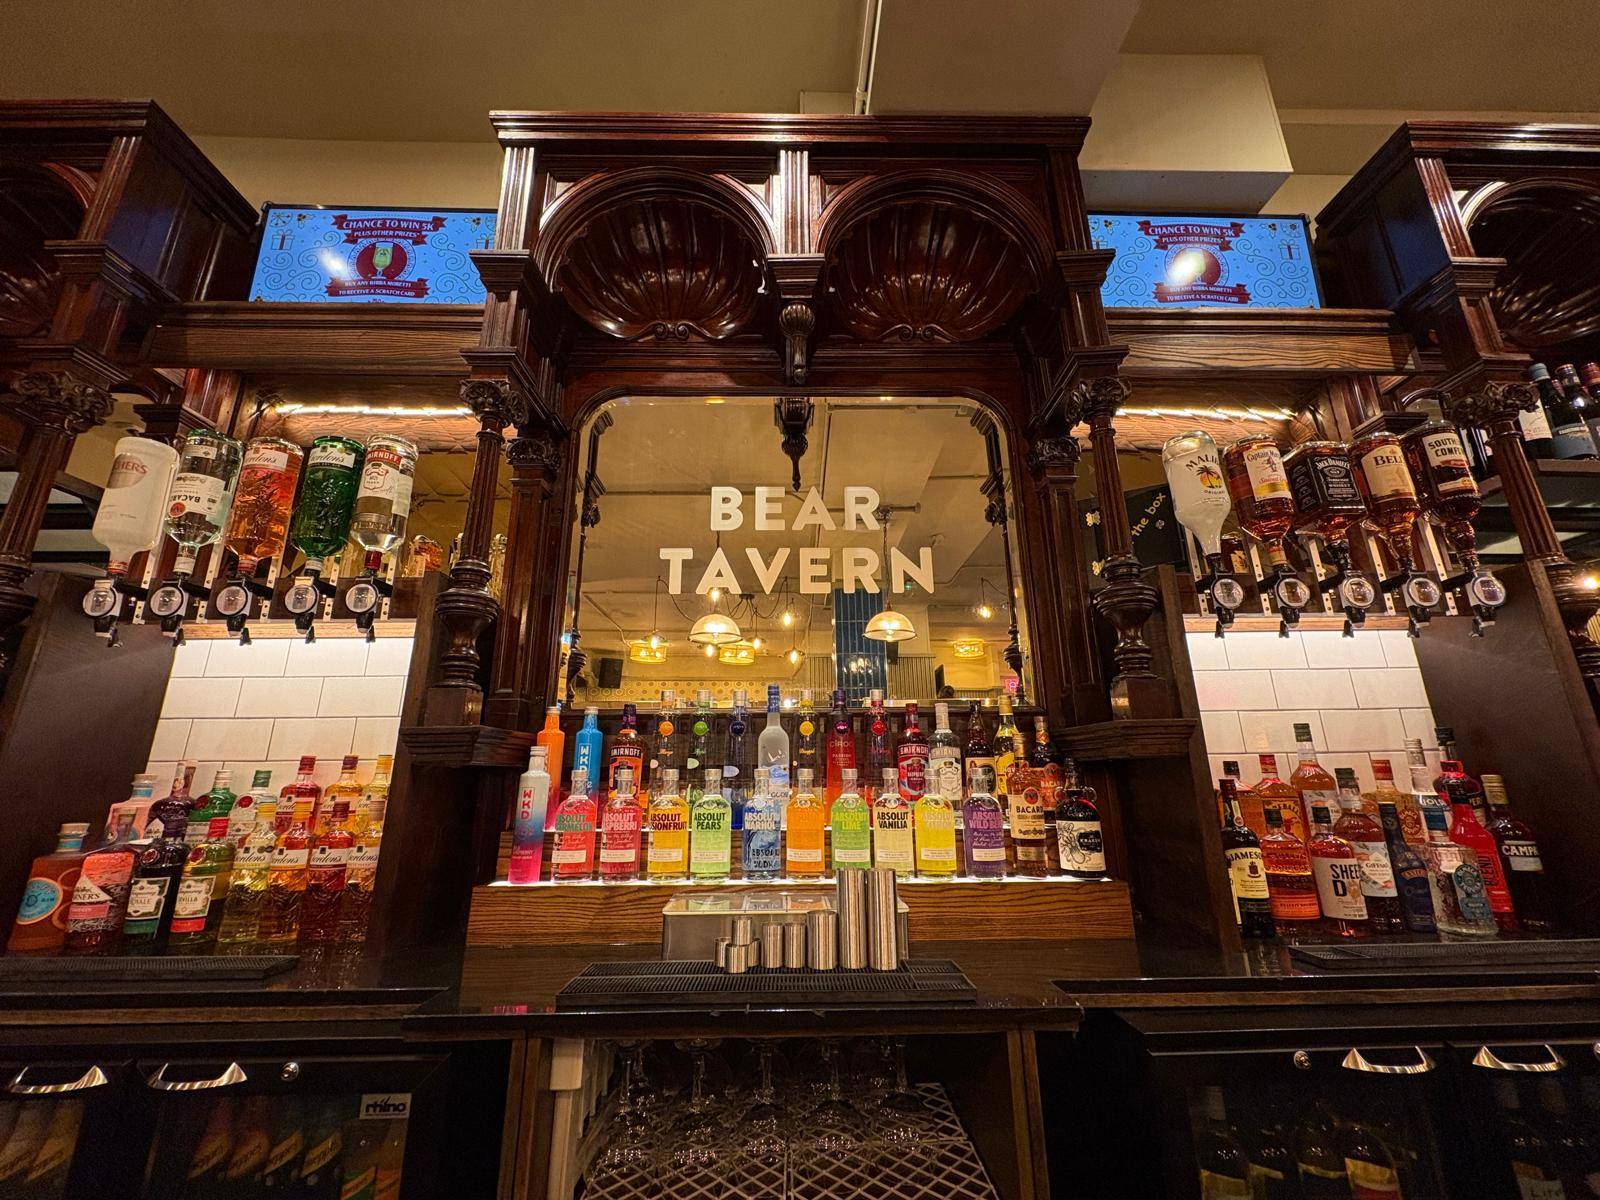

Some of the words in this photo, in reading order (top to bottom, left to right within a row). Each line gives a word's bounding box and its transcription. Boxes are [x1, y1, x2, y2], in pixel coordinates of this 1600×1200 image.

[343, 220, 382, 229] CHANCE
[383, 220, 398, 228] TO
[400, 221, 420, 229] WIN
[422, 223, 434, 231] 5K
[1149, 225, 1186, 235] CHANCE
[1187, 225, 1200, 233] TO
[1201, 226, 1221, 235] WIN
[1223, 228, 1235, 236] 5K
[1247, 449, 1270, 463] Captain
[710, 486, 881, 531] BEAR
[1131, 517, 1149, 537] the
[1144, 493, 1166, 516] box
[659, 547, 935, 595] TAVERN
[900, 745, 929, 756] SMIRNOFF
[521, 789, 533, 820] WKD
[694, 813, 726, 821] ABSOLUT
[745, 812, 776, 821] ABSOLUT
[833, 812, 867, 821] ABSOLUT
[877, 811, 909, 820] ABSOLUT
[696, 821, 722, 830] PEARS
[745, 820, 776, 830] WARHOL
[841, 821, 861, 830] LIME
[878, 820, 908, 829] VANILIA
[968, 819, 989, 829] WILD
[365, 1096, 407, 1113] rhino
